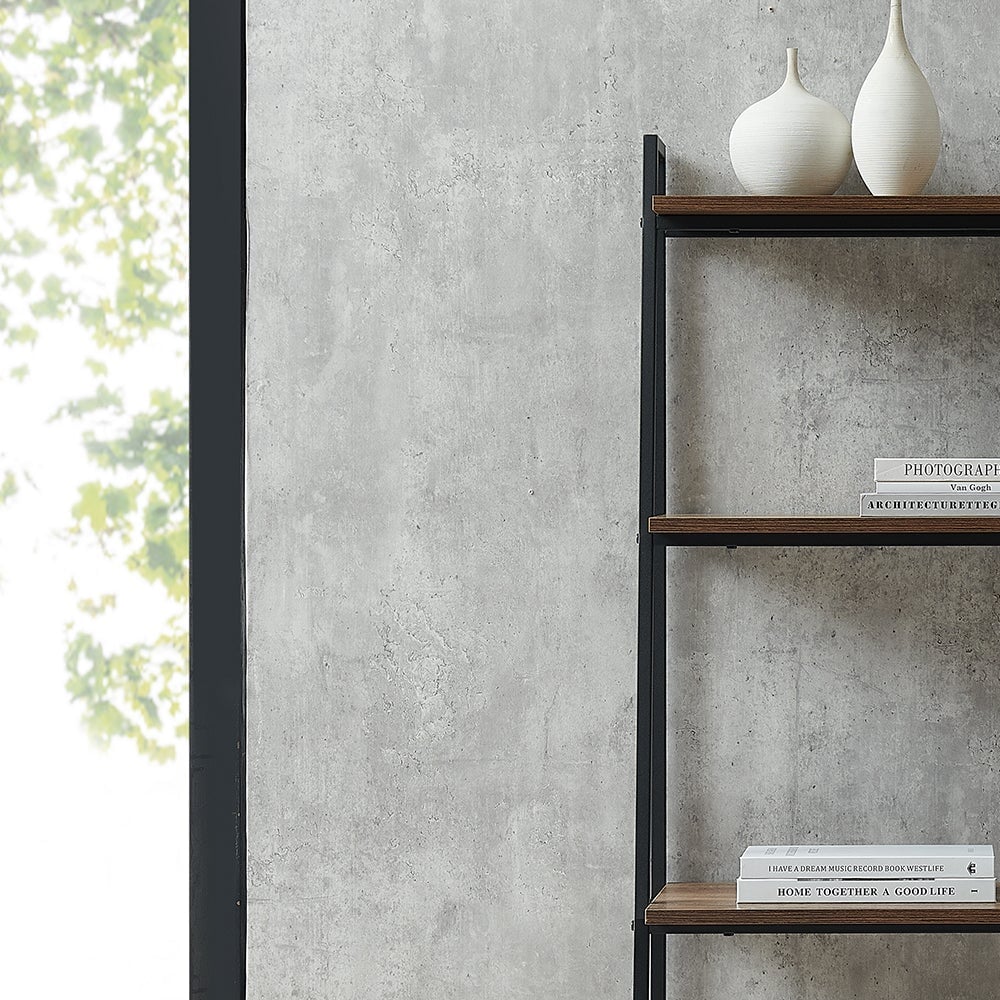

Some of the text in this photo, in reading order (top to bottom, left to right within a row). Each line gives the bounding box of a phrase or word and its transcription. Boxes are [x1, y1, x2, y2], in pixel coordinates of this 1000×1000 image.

[950, 483, 992, 493] Van Gogh
[778, 887, 956, 897] HOME TOGETHER A GOOD LIFE
